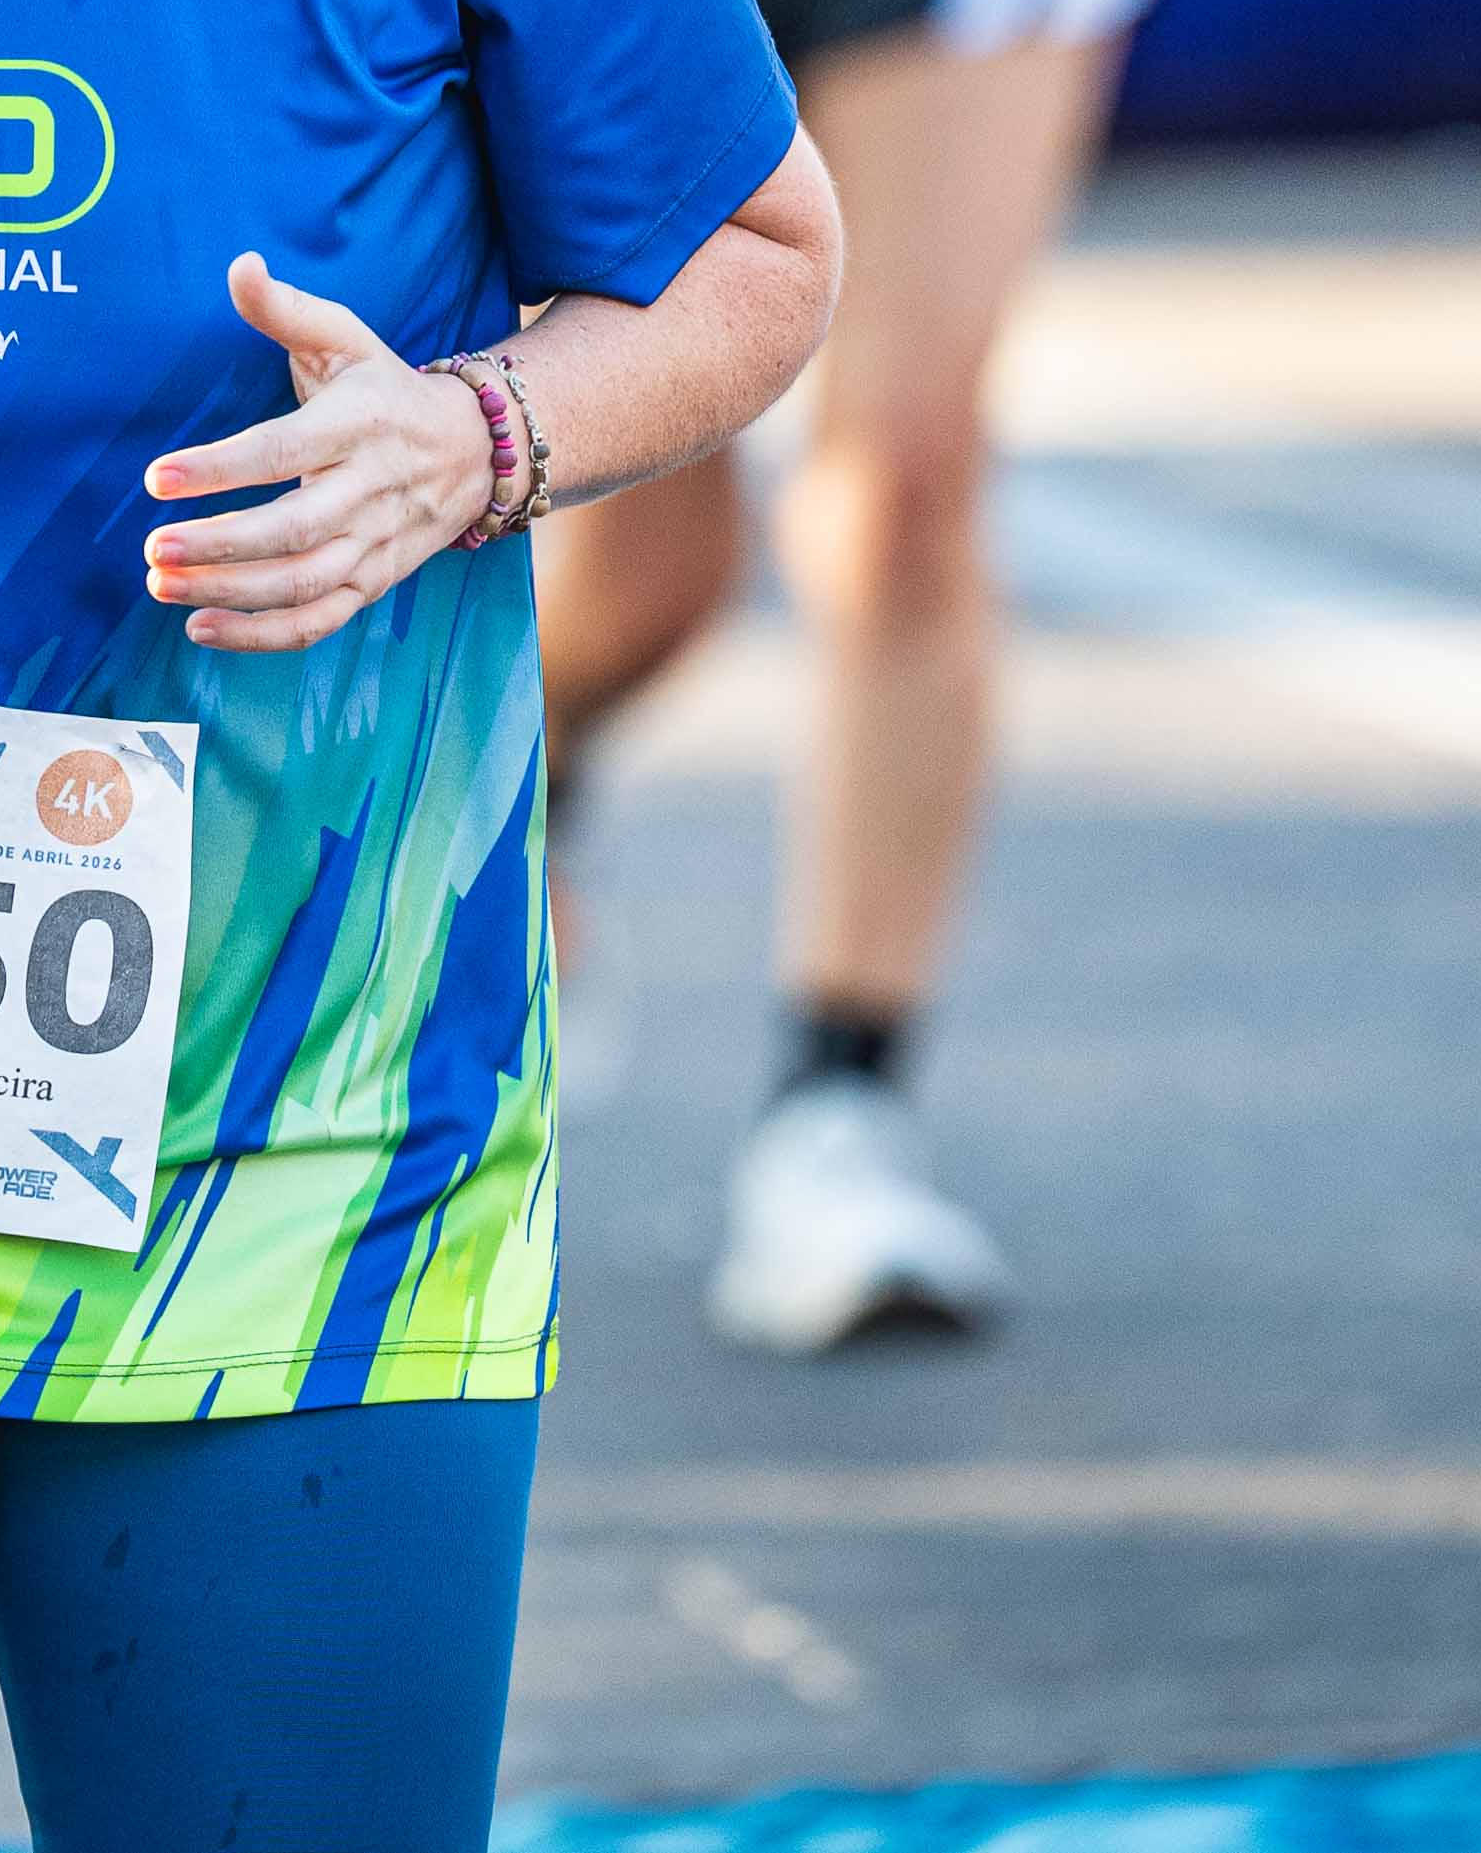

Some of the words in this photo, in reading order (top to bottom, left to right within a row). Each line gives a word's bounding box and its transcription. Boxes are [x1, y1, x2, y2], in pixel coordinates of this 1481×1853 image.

[53, 778, 116, 822] 4K
[22, 849, 73, 866] ABRIL
[81, 854, 122, 871] 2026
